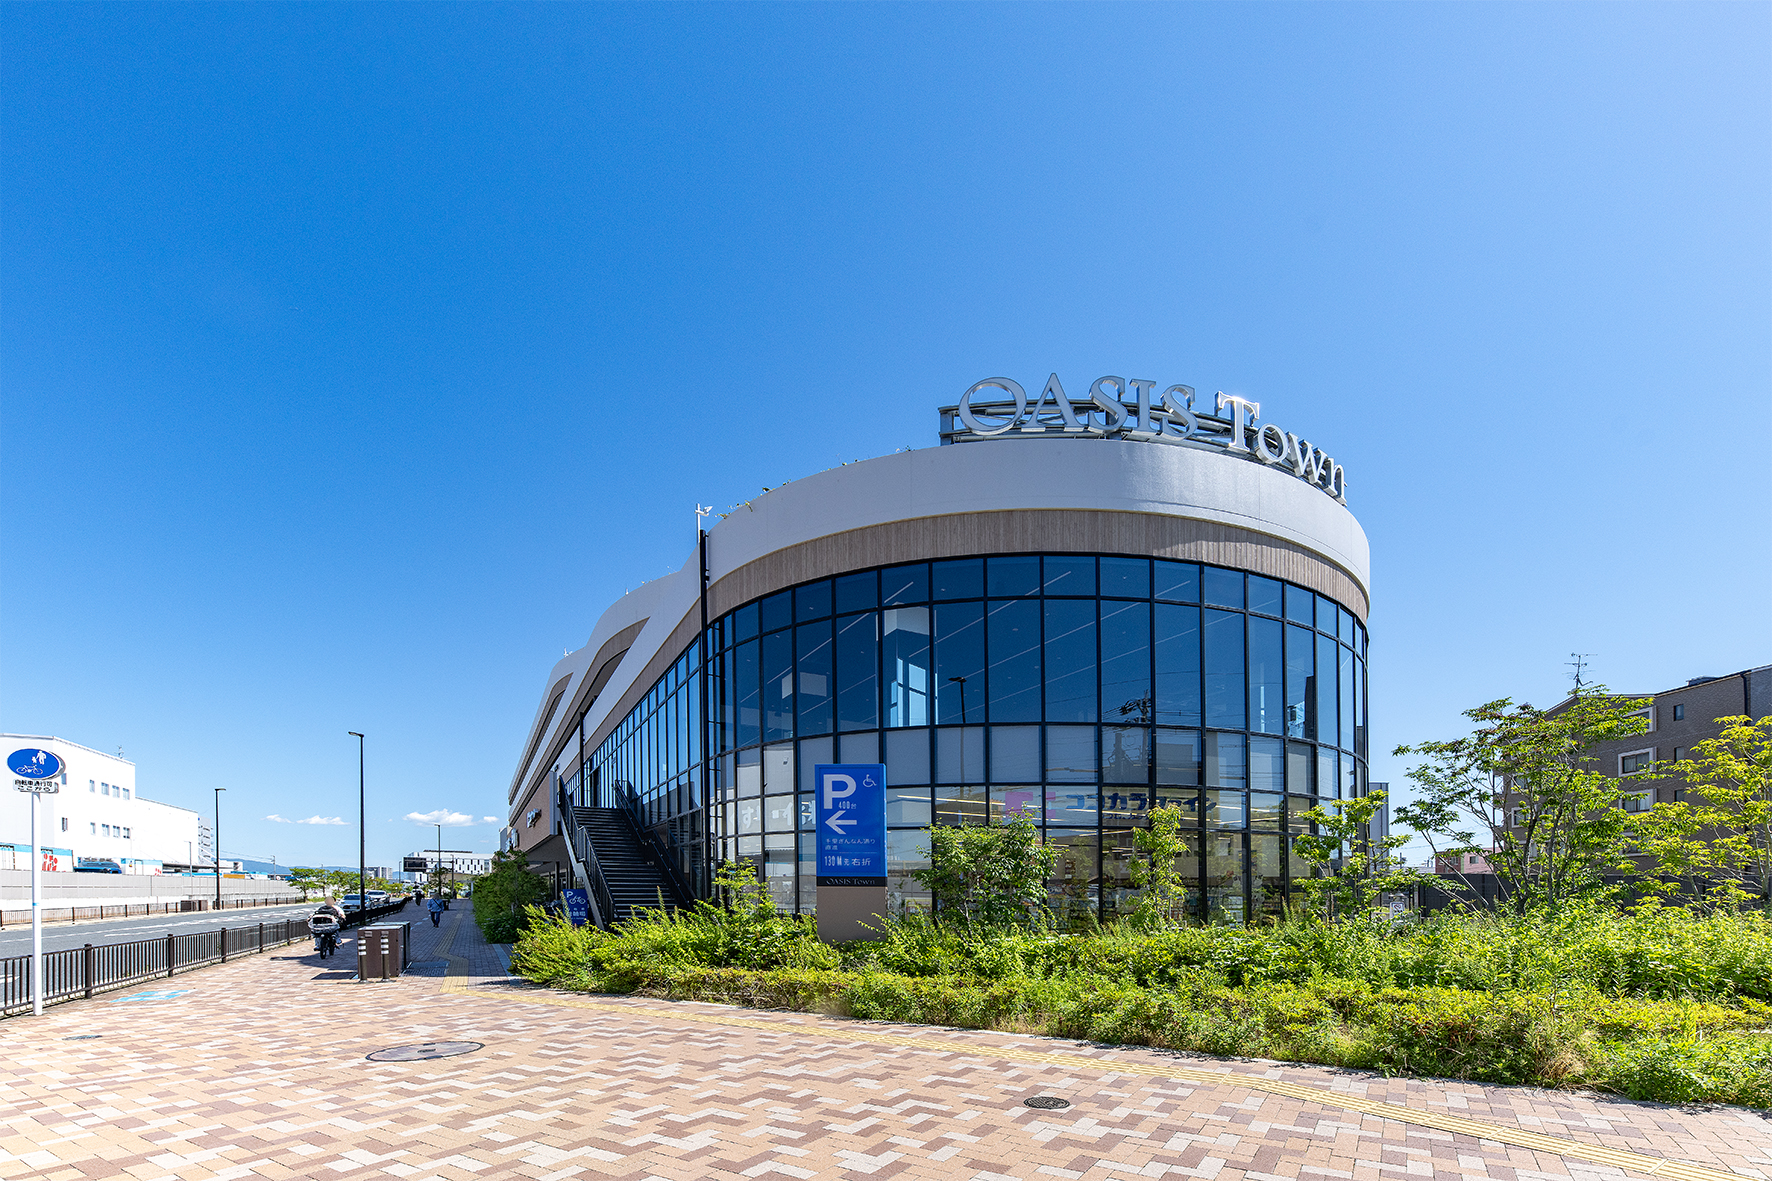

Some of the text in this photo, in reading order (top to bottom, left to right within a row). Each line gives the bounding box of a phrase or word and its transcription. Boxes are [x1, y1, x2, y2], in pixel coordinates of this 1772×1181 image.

[959, 373, 1348, 507] OASIS Town
[823, 774, 857, 809] P
